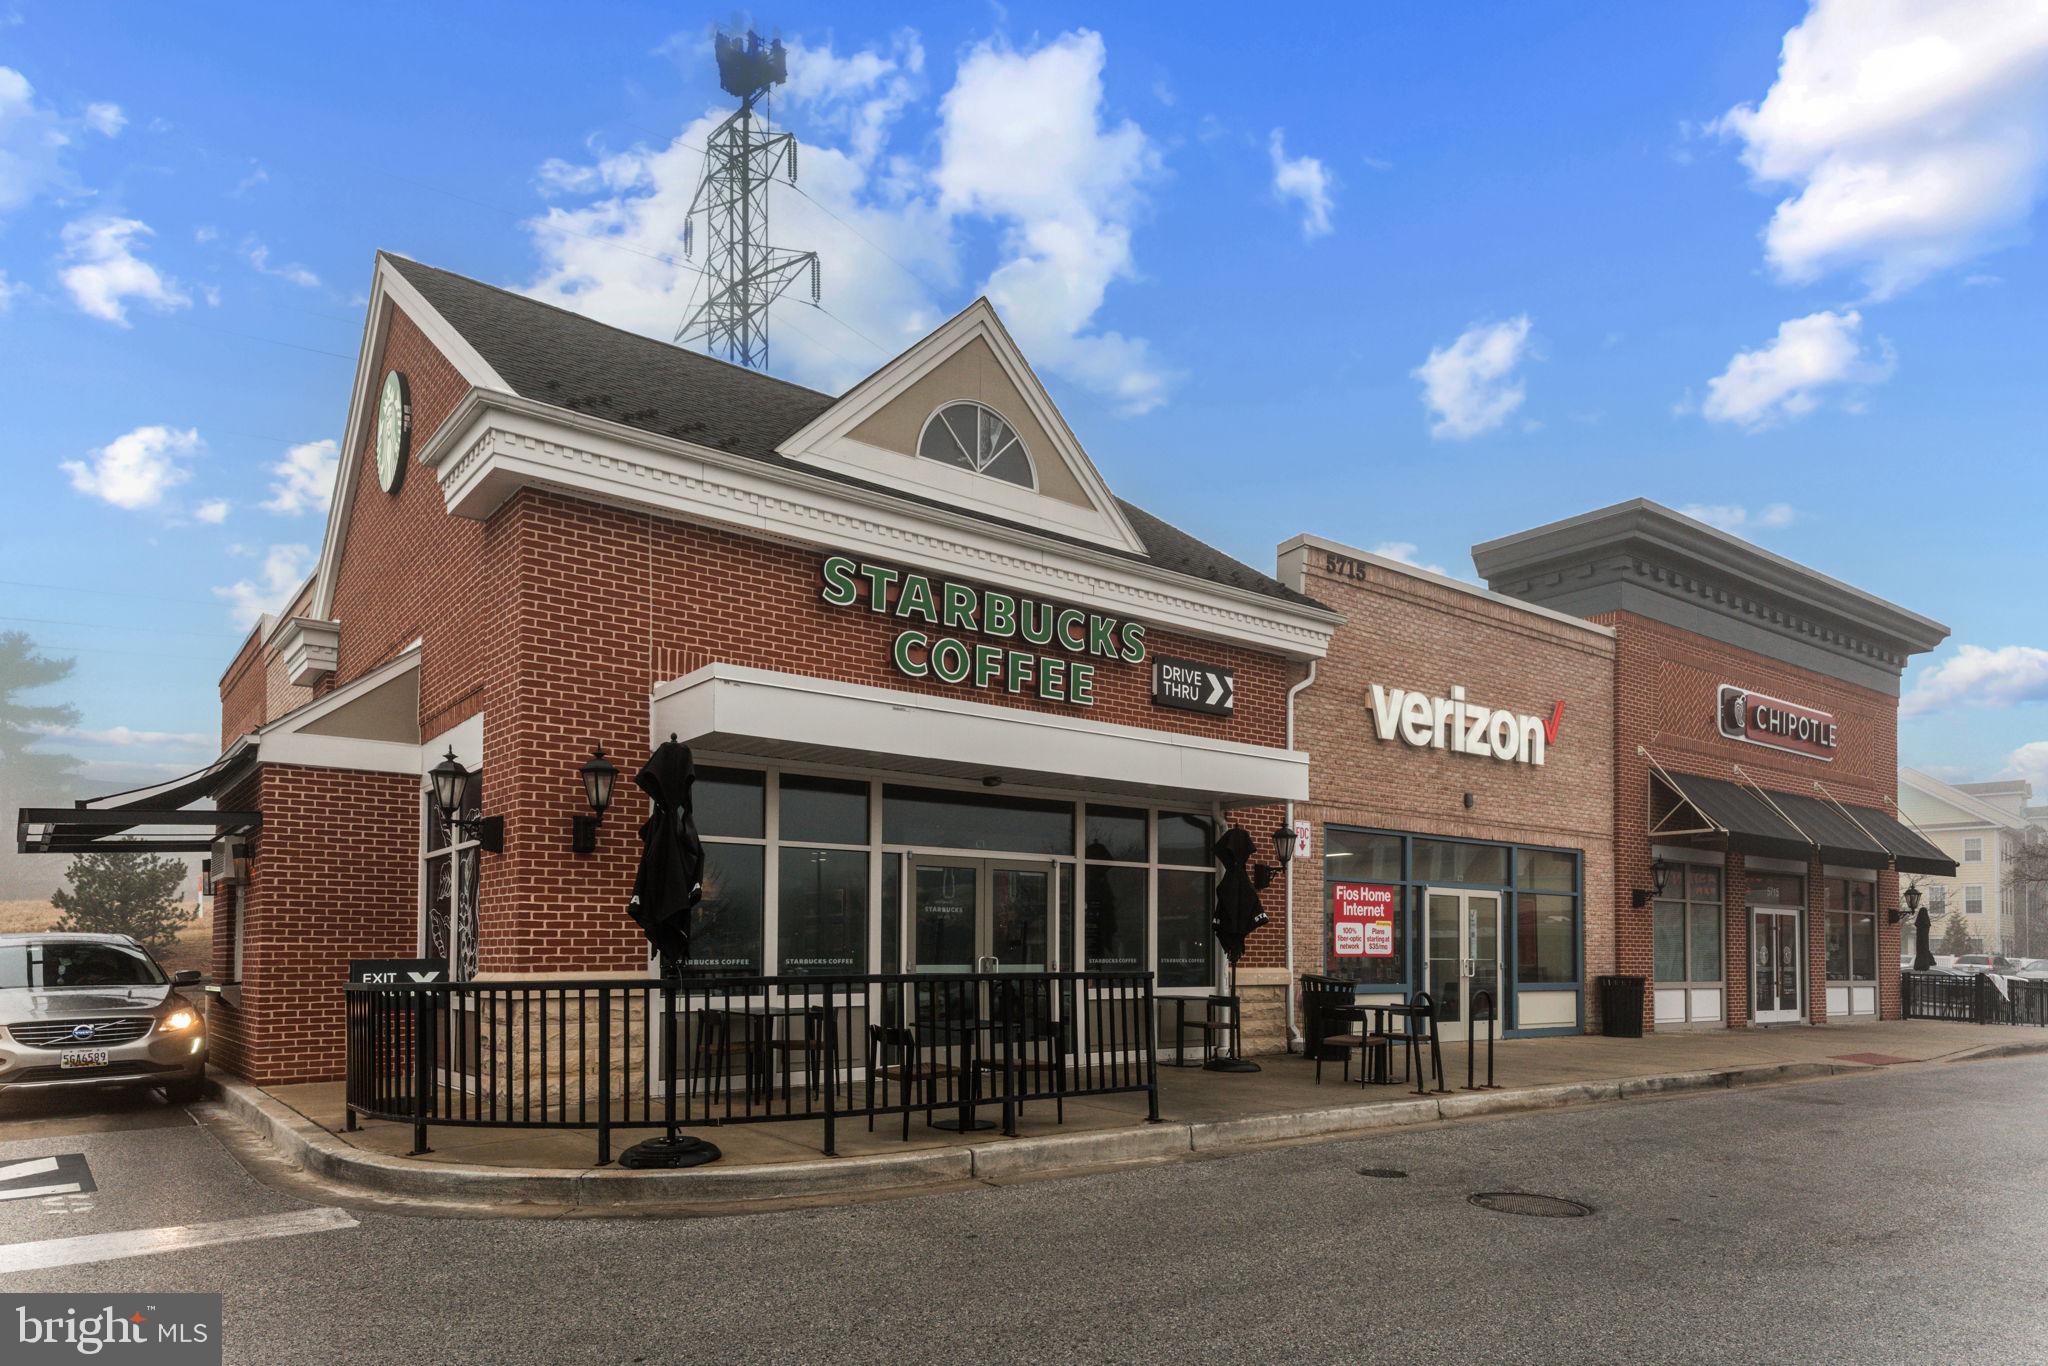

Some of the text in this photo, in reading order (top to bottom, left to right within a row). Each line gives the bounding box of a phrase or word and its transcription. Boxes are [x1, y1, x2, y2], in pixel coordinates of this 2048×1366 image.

[1327, 554, 1366, 580] 5715
[822, 556, 1147, 663] STARBUCKS
[894, 631, 1095, 706] COFFEE
[1163, 664, 1202, 686] DRIVE
[1163, 681, 1199, 701] THRU
[1368, 683, 1545, 765] verizon
[1756, 704, 1837, 748] CHIPOTLE
[1296, 827, 1309, 839] FDC
[1336, 885, 1391, 902] Fios Home
[1343, 901, 1385, 917] Internet
[721, 958, 750, 966] COFFEE
[362, 972, 397, 984] EXIT
[63, 1051, 106, 1066] 5GA6589
